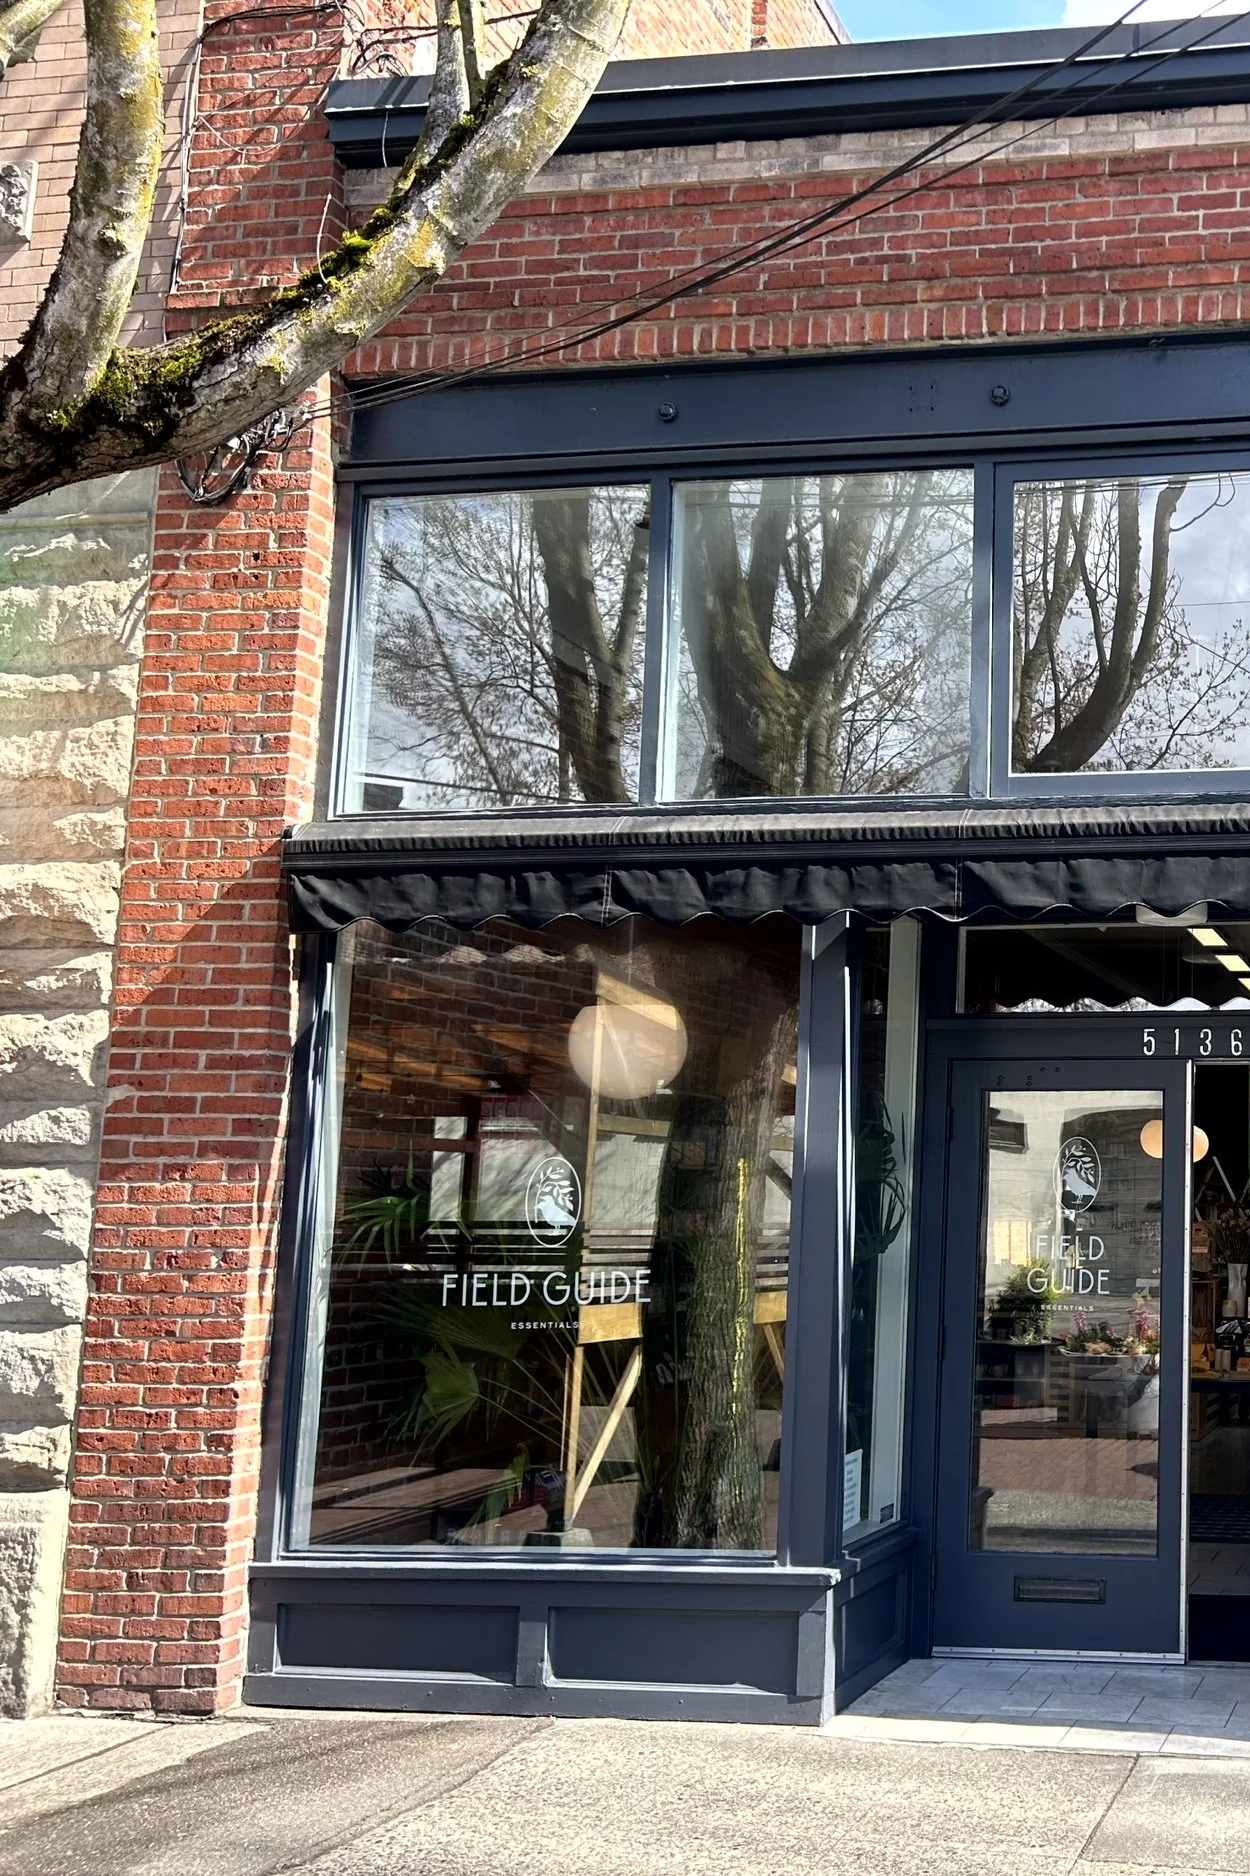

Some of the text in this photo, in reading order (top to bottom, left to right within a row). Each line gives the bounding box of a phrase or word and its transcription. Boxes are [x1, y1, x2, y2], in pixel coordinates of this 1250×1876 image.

[1143, 1028, 1243, 1056] 5136
[1036, 1235, 1105, 1261] FIELD
[442, 1269, 651, 1307] FIELD GUIDE
[1026, 1267, 1110, 1295] GUIDE
[1040, 1304, 1094, 1312] ESSENTIALS
[510, 1321, 581, 1330] ESSENTIALS
